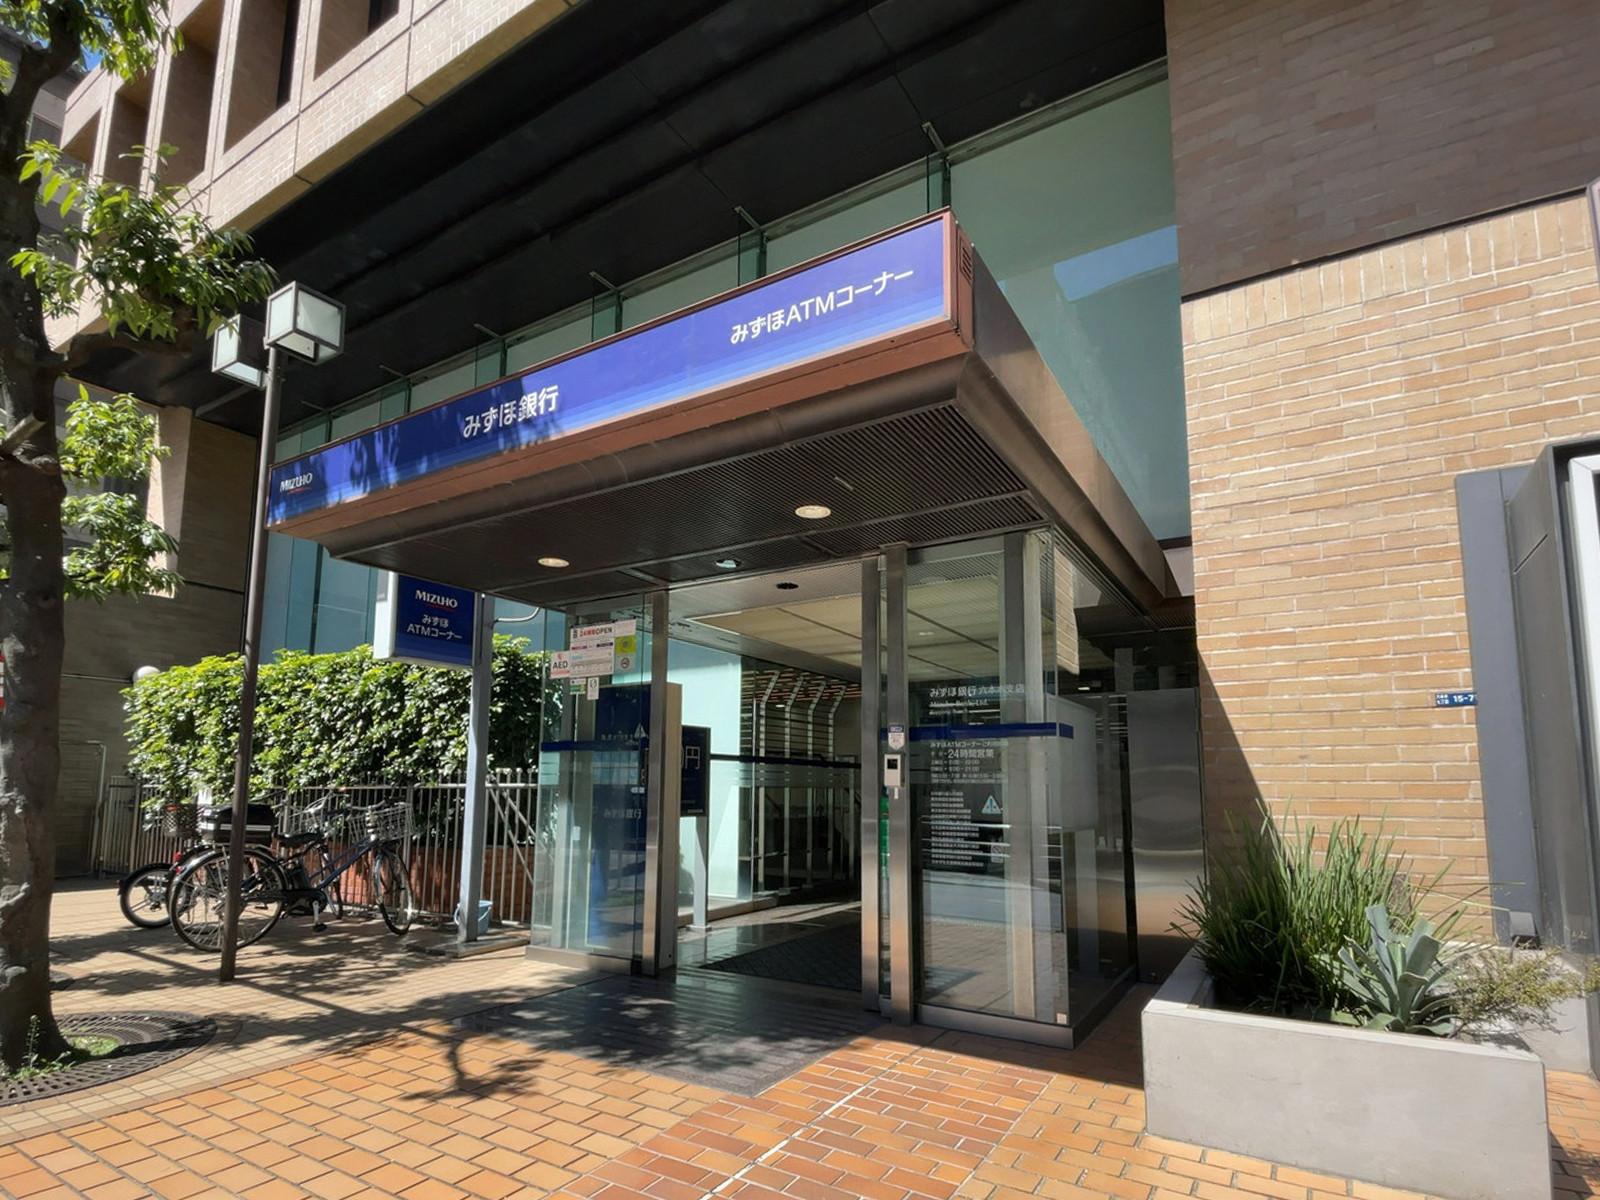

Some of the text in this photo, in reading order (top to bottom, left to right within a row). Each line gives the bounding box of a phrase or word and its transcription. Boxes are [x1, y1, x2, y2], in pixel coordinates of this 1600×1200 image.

[730, 270, 914, 344] みずほATMコーナー
[463, 384, 559, 438] みずほ銀行
[279, 472, 313, 493] MIZUHO
[415, 590, 458, 609] MIZUHO
[422, 614, 449, 628] みずほ
[407, 623, 463, 640] ATMコーナー
[552, 661, 568, 669] AED
[929, 686, 976, 698] みずほ銀行
[1452, 694, 1474, 703] 15-7
